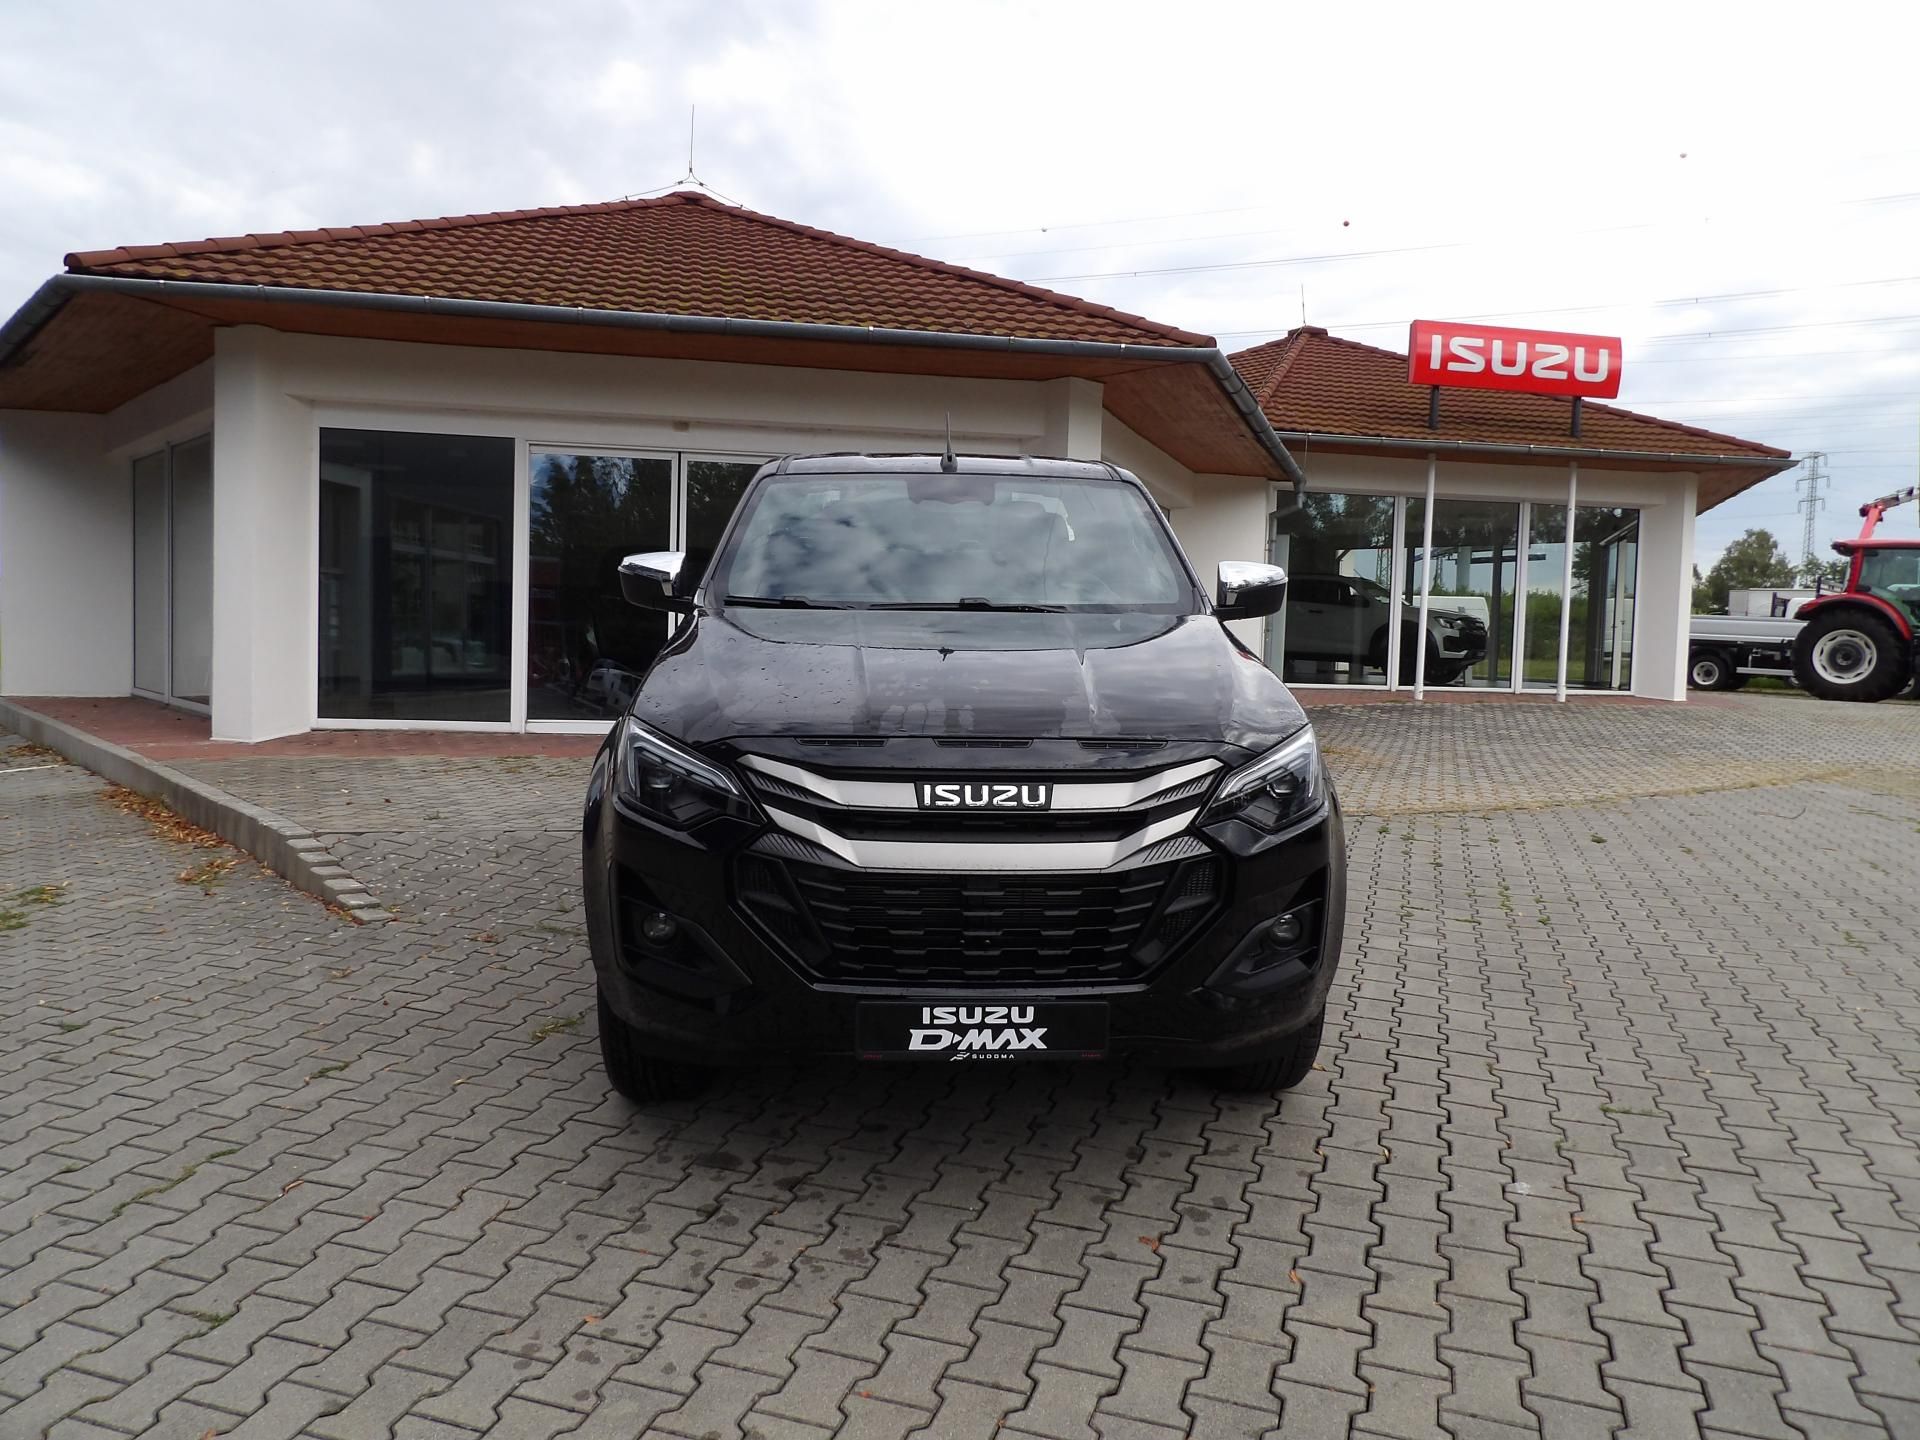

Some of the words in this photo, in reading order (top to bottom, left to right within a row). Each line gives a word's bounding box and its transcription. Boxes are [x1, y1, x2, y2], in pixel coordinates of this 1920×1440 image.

[1429, 334, 1609, 383] ISUZU
[923, 784, 1046, 807] ISUZU
[922, 1006, 1035, 1025] ISUZU
